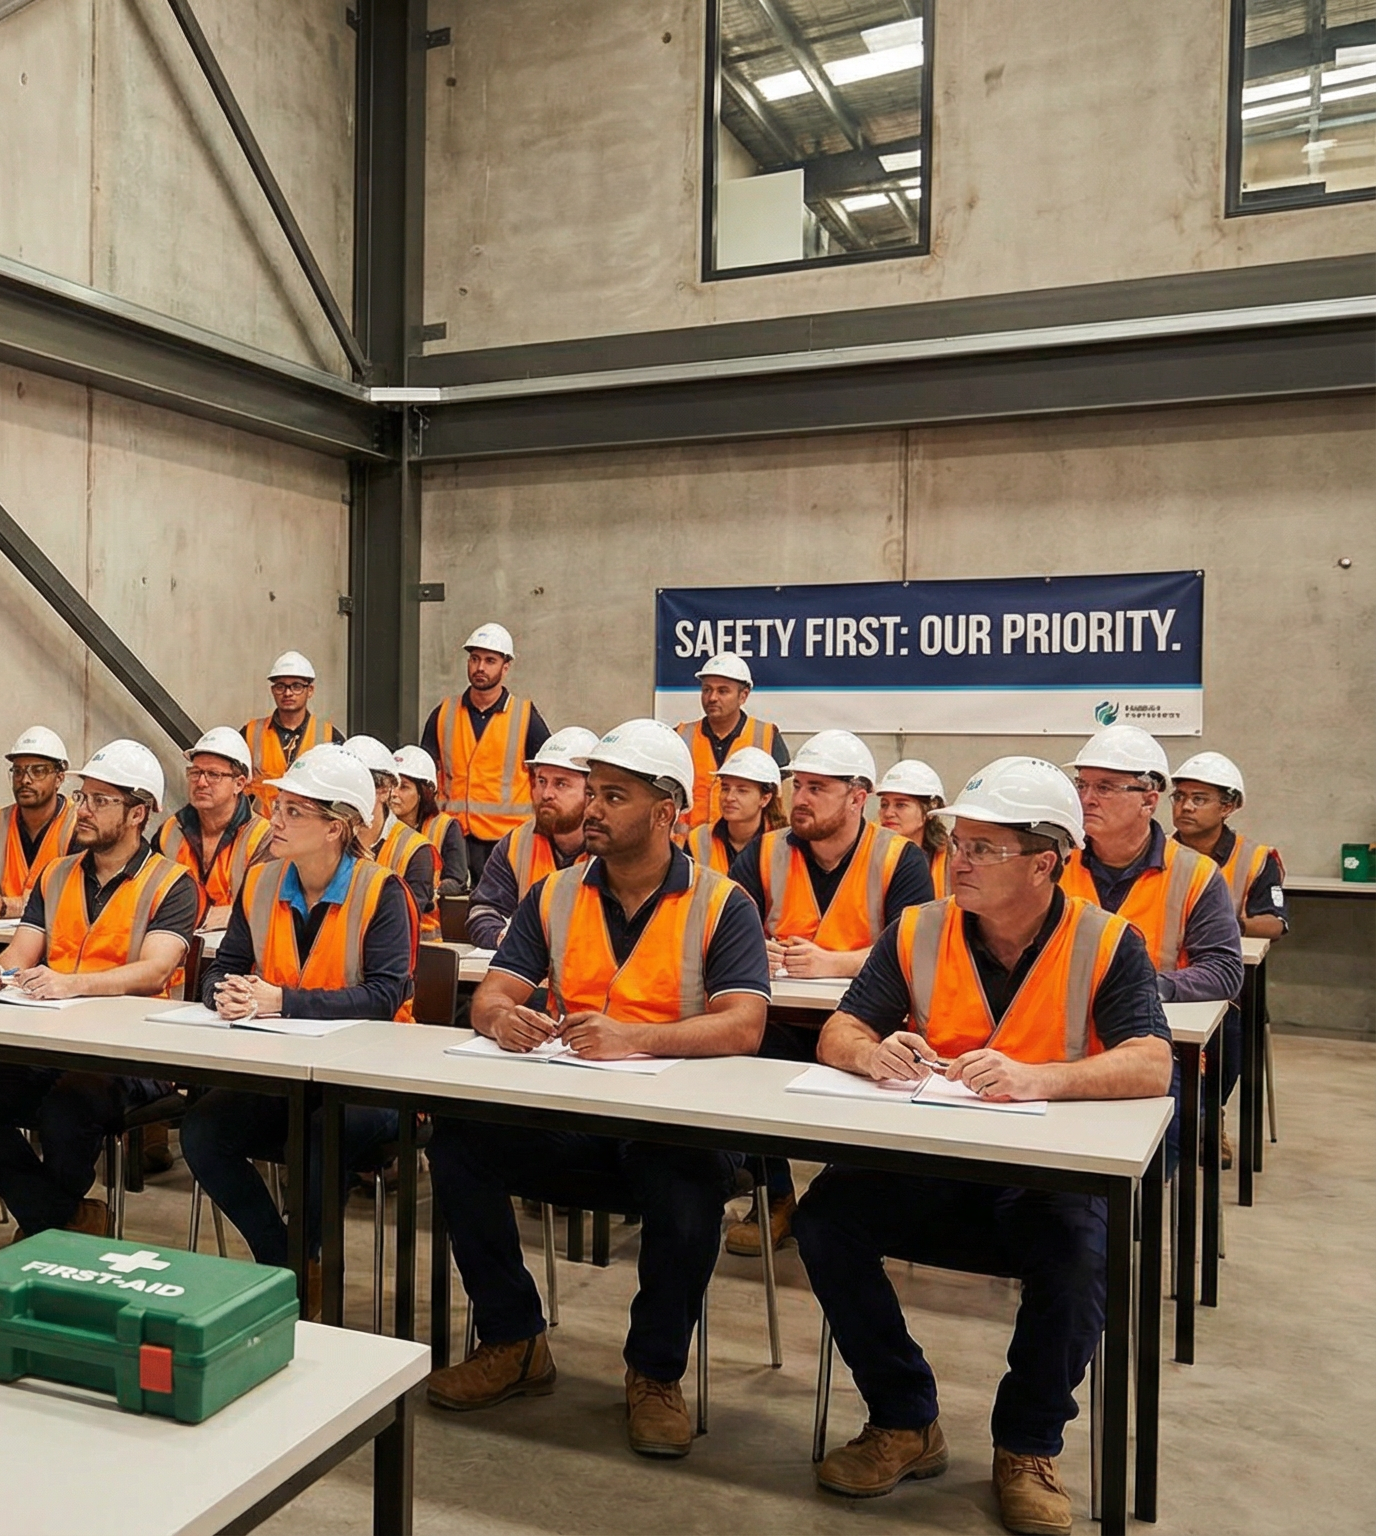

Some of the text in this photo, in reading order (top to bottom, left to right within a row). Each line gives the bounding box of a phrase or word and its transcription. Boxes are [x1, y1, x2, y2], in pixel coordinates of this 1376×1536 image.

[674, 608, 1182, 658] SAFETY FIRST: OUR PRIORITY.
[21, 1260, 186, 1297] FIRST-AID
